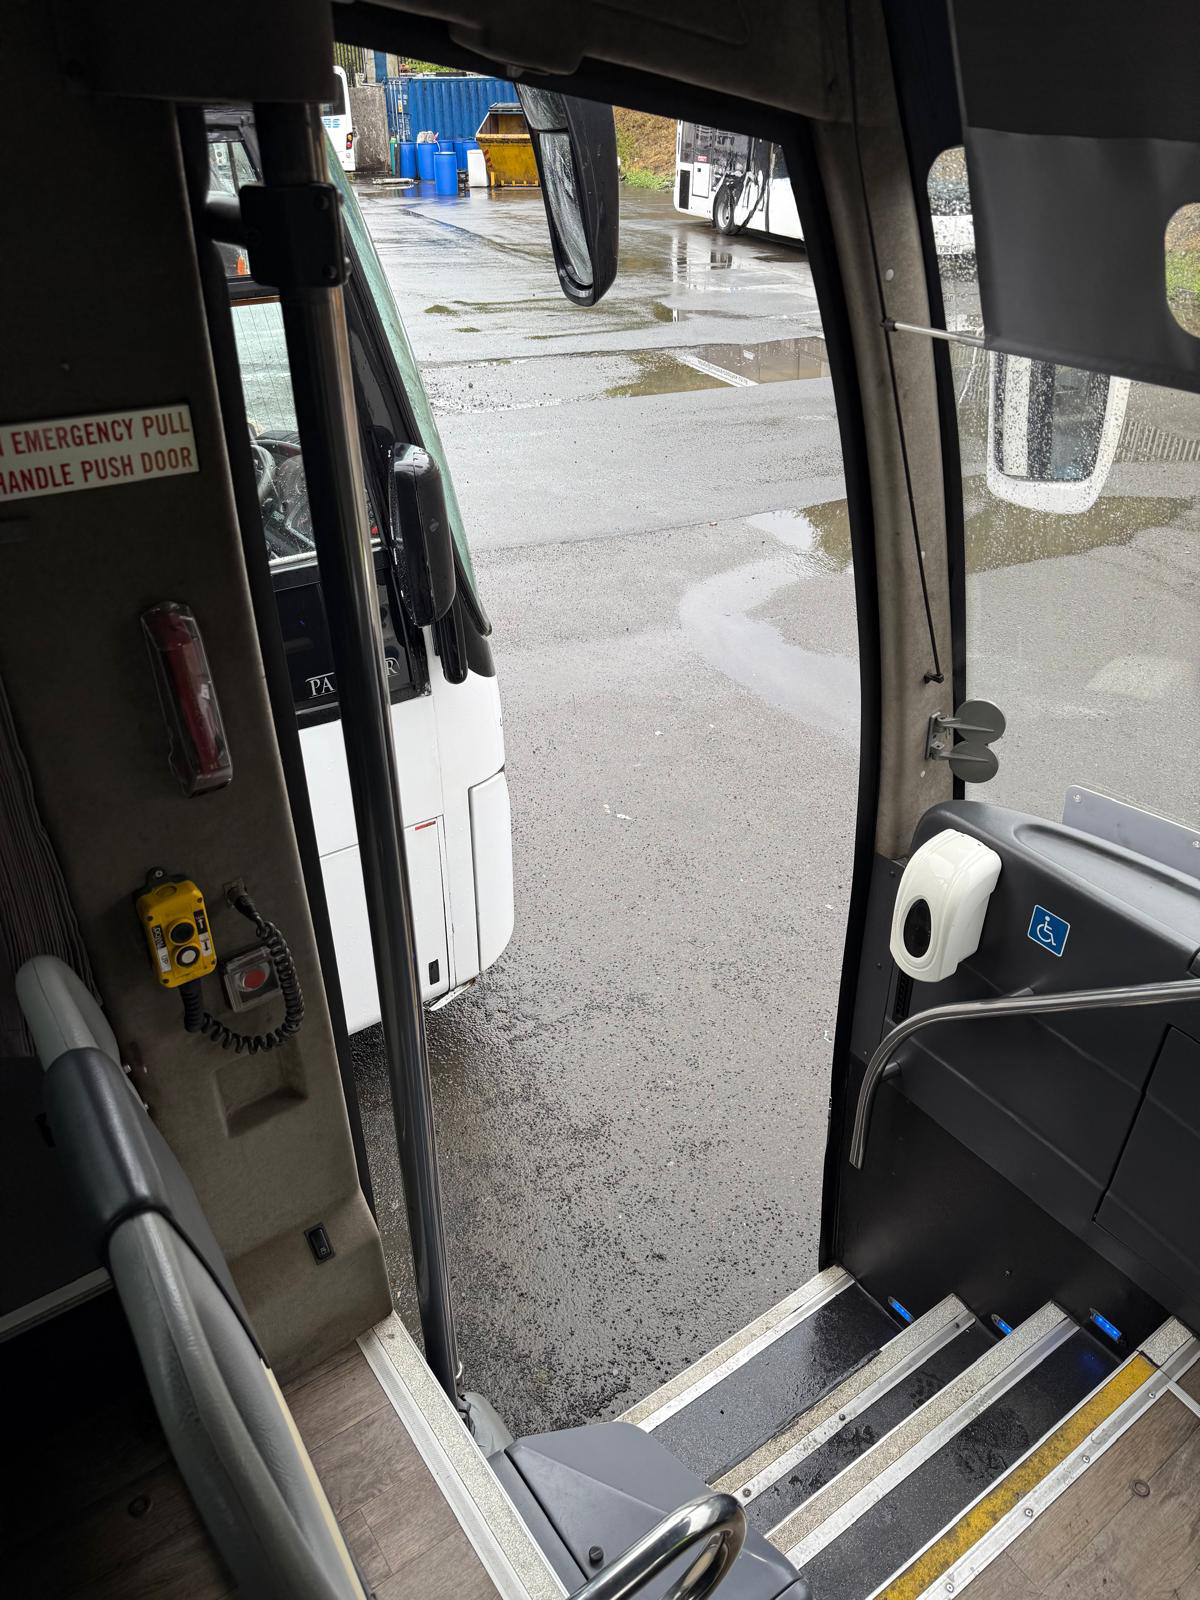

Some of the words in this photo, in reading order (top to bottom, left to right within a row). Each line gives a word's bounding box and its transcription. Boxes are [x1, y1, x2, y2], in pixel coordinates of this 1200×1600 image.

[11, 417, 134, 455] EMERGENCY
[142, 411, 190, 438] PULL
[80, 454, 134, 483] PUSH
[140, 446, 193, 473] DOOR
